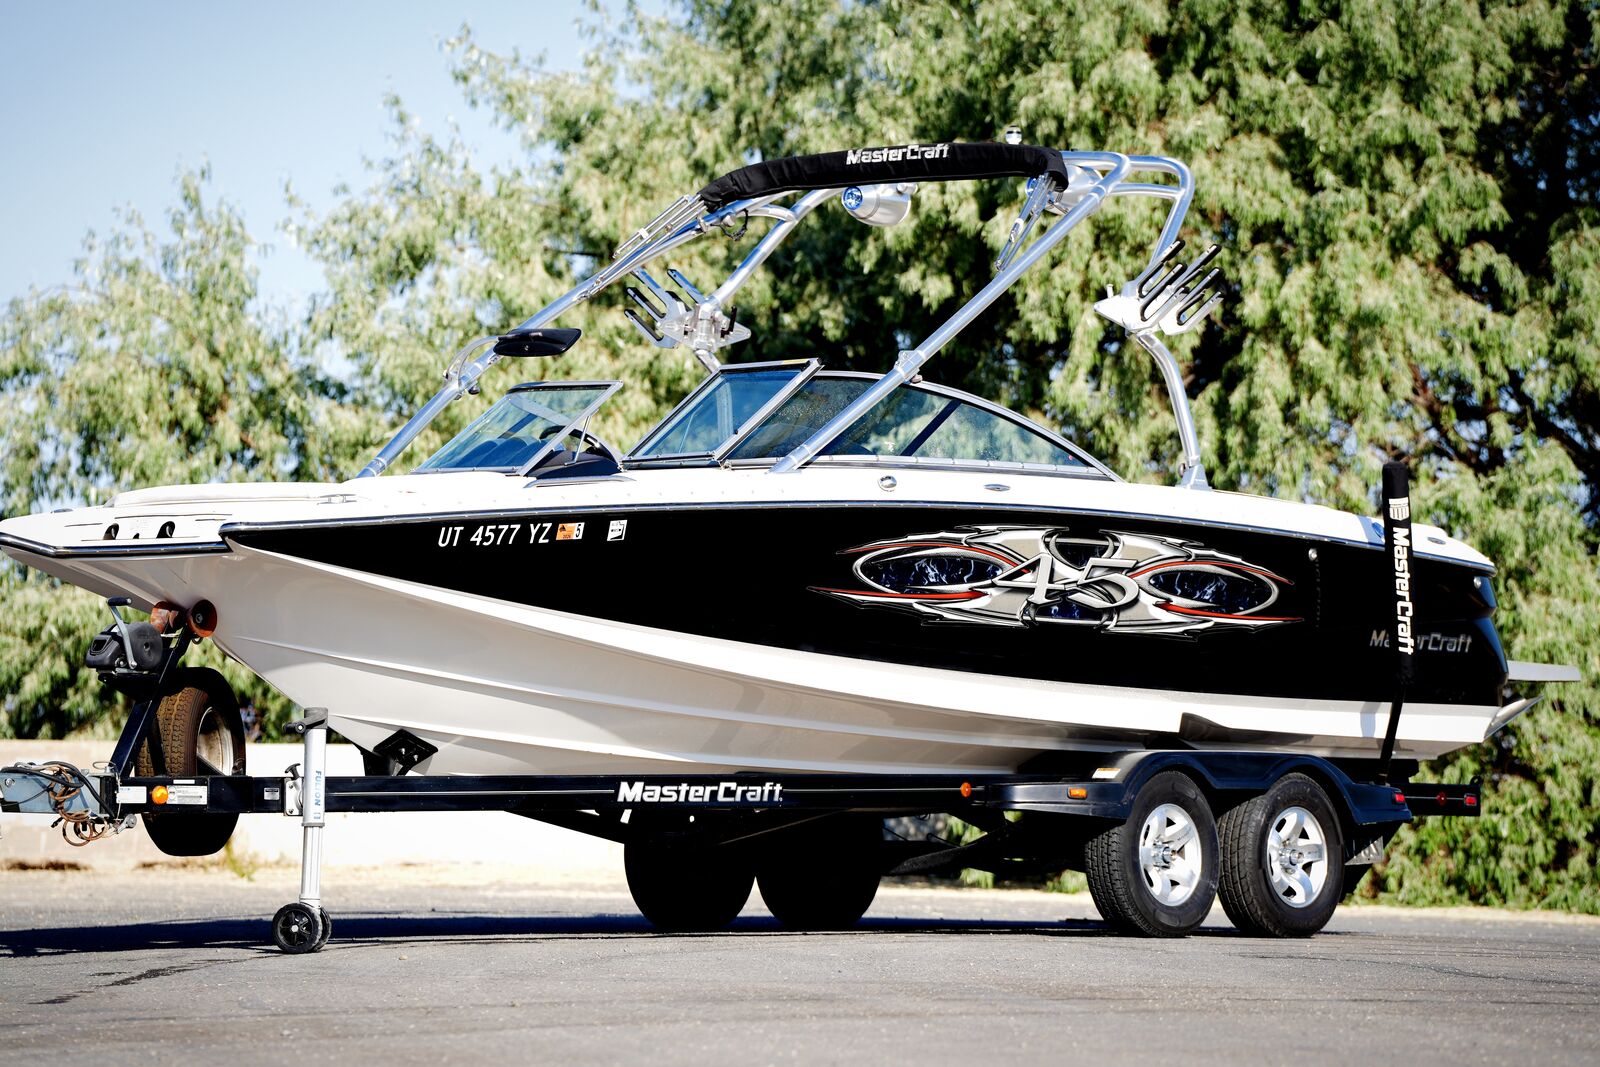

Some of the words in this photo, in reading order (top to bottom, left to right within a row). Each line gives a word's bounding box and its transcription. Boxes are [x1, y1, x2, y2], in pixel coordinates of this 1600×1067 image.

[846, 143, 949, 165] MasterCraft
[438, 526, 464, 547] UT
[470, 524, 521, 545] 4577
[529, 522, 552, 543] YZ
[1392, 527, 1414, 655] MasterCraft
[617, 781, 783, 803] MasterCraft
